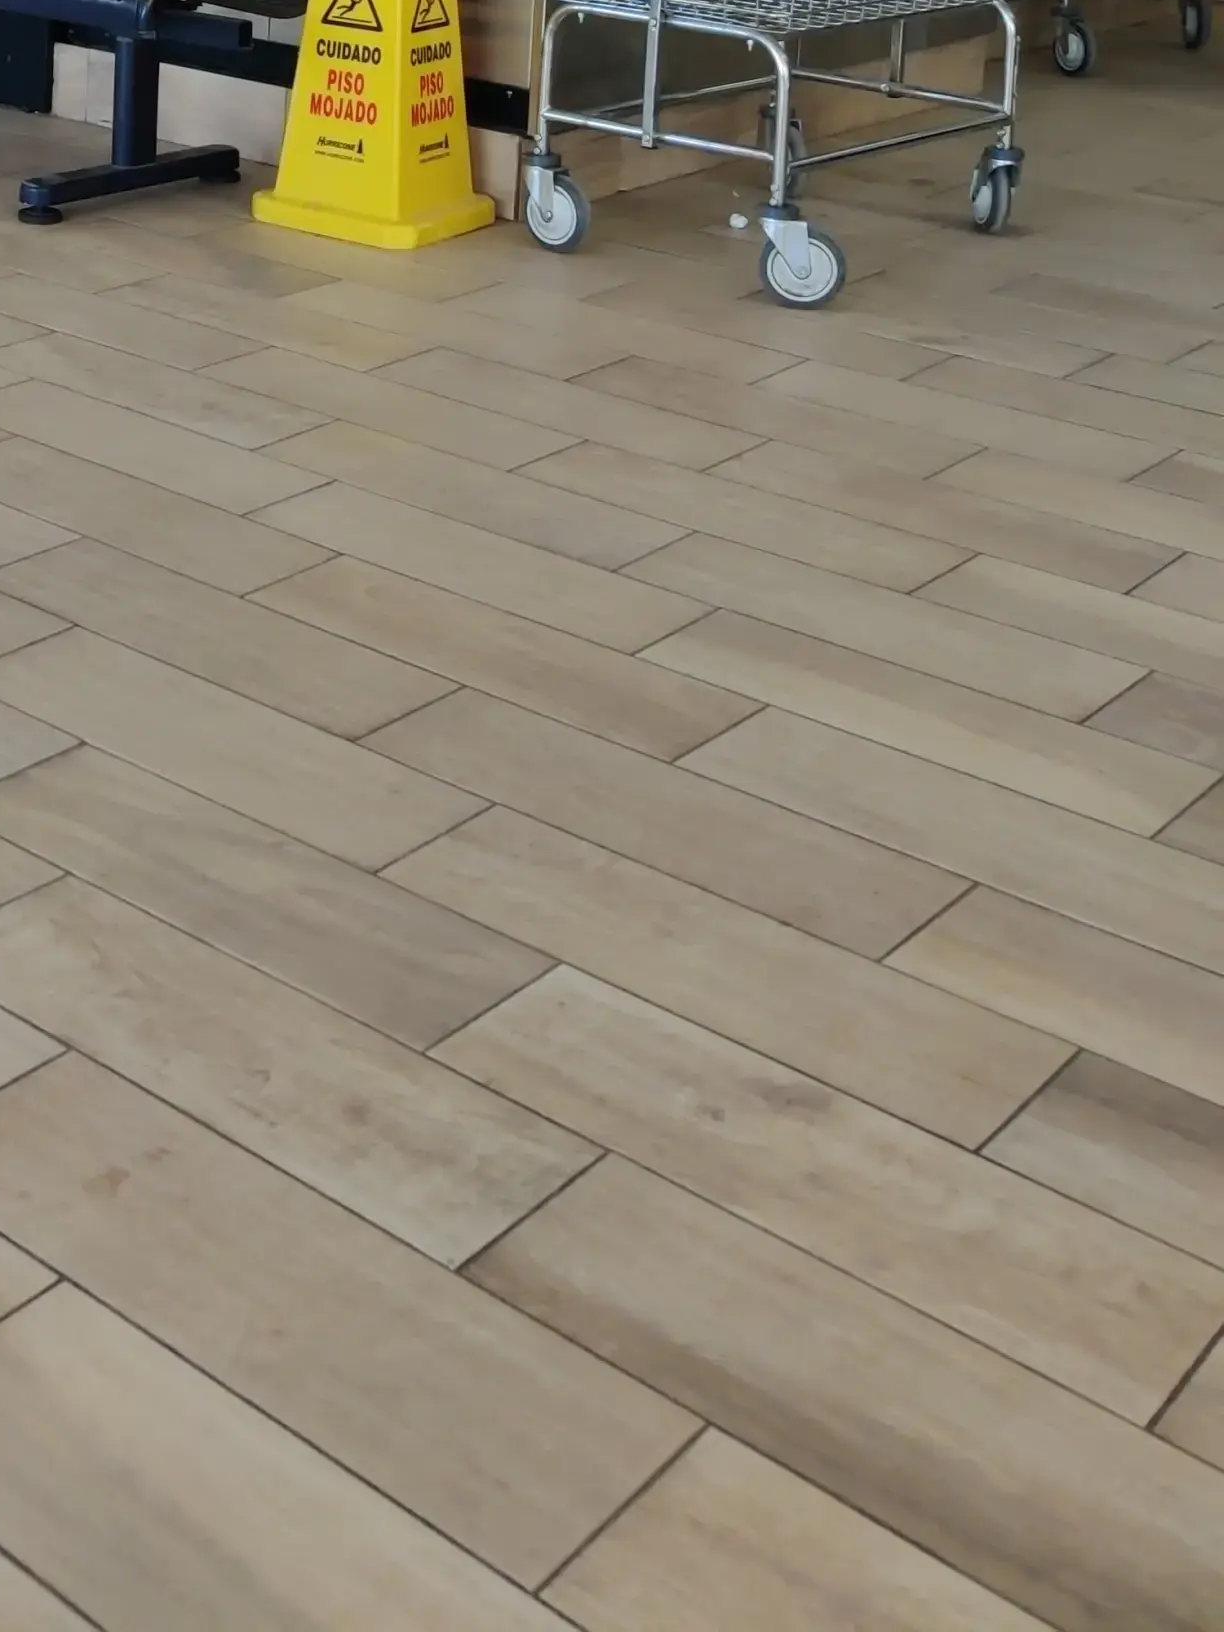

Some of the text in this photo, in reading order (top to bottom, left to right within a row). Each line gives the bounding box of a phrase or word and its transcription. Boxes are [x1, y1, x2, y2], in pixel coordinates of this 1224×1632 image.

[316, 38, 382, 65] CUIDADO
[410, 41, 452, 67] CUIDADO
[327, 69, 365, 96] PISO
[419, 71, 444, 98] PISO
[310, 92, 378, 125] MOJADO
[410, 96, 454, 127] MOJADO
